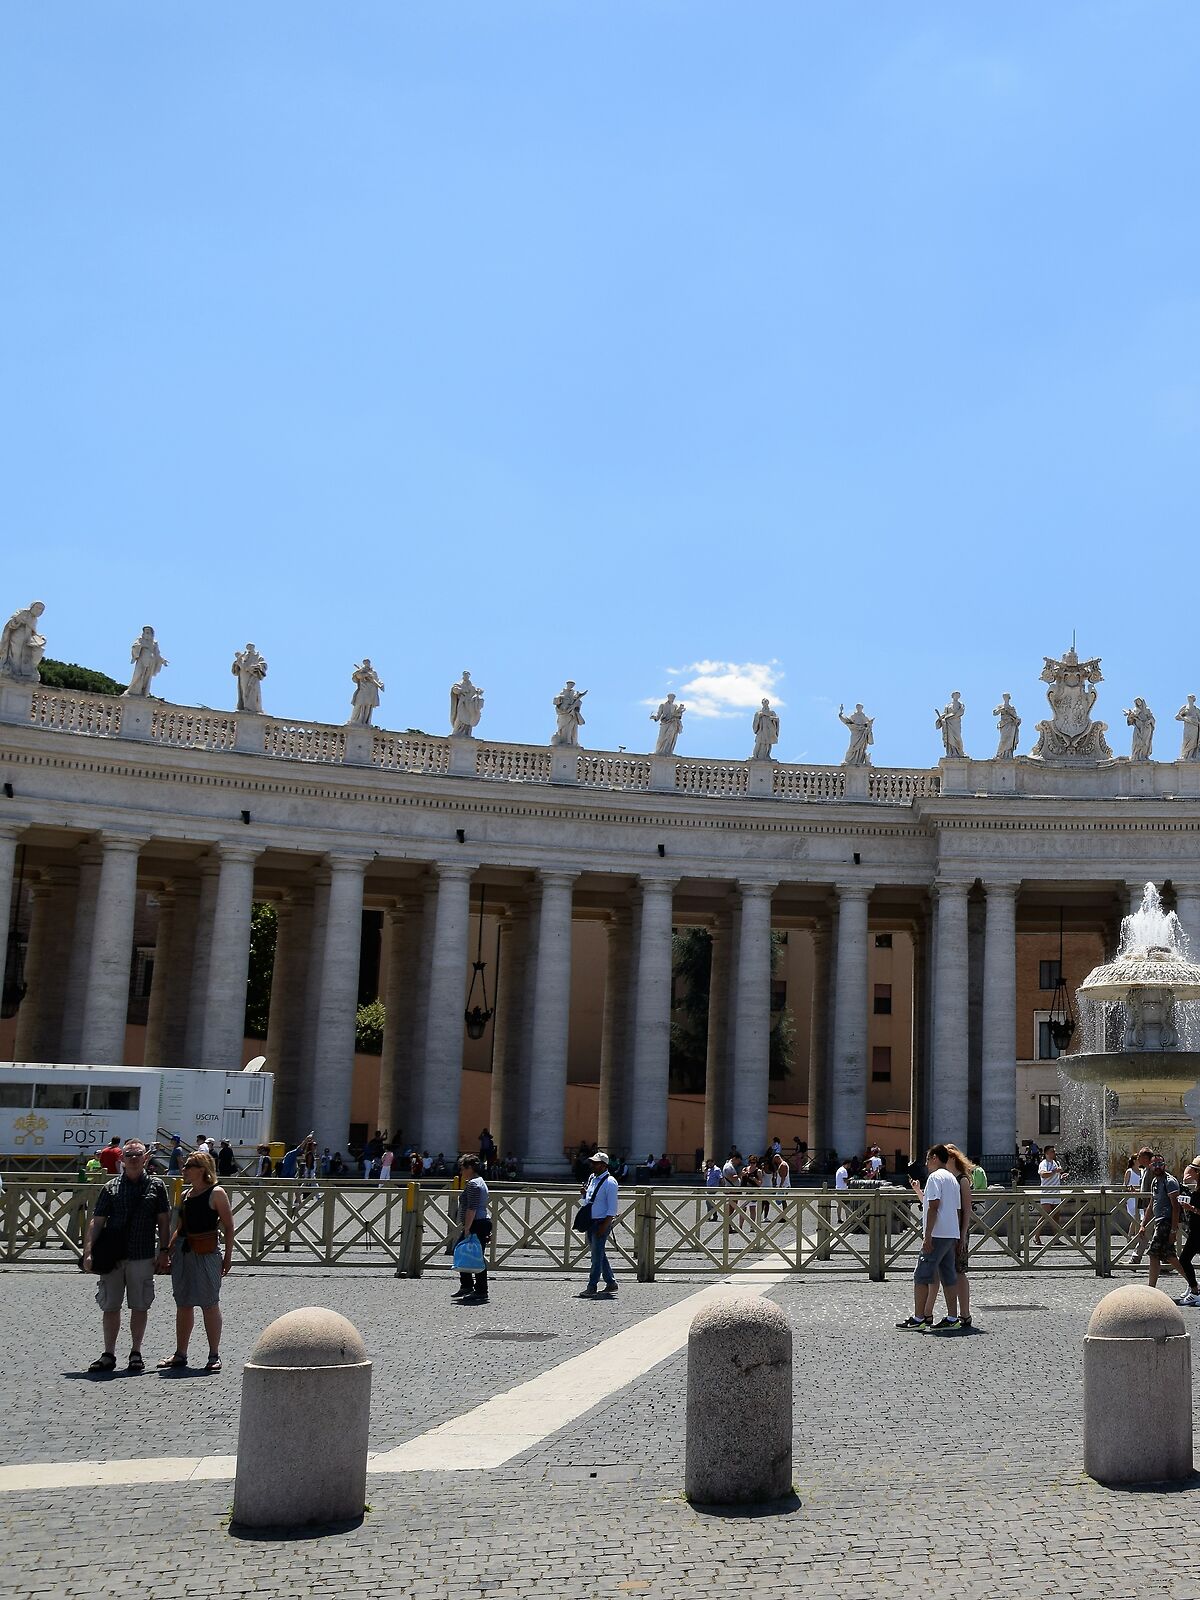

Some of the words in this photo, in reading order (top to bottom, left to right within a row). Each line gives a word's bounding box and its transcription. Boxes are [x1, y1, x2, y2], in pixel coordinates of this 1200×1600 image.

[64, 1116, 110, 1127] VATICAN
[195, 1113, 220, 1121] USCITA
[63, 1129, 108, 1144] POST
